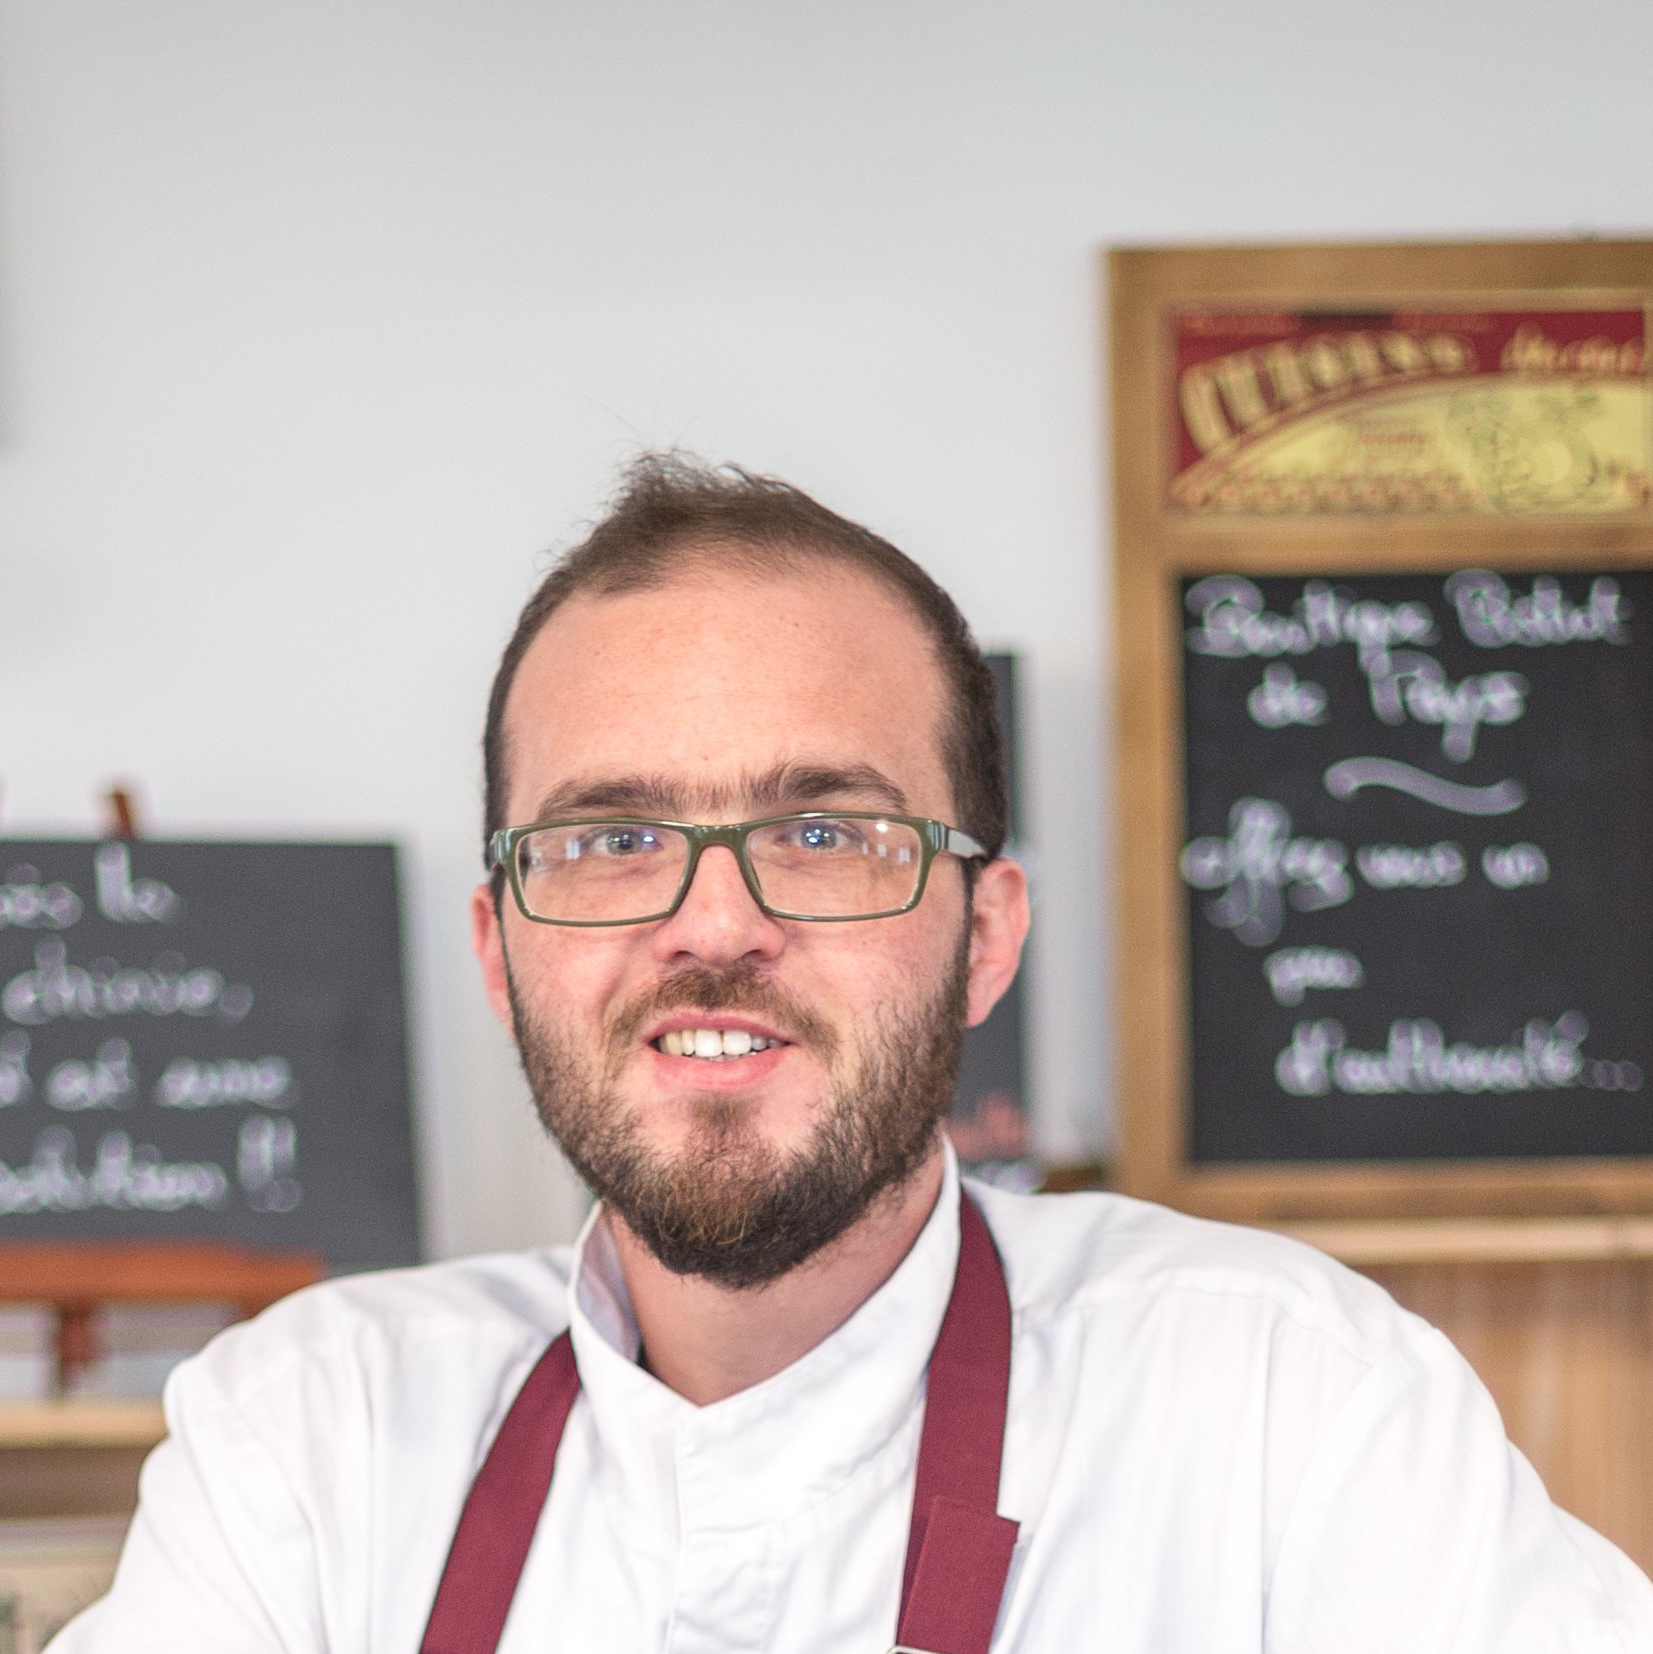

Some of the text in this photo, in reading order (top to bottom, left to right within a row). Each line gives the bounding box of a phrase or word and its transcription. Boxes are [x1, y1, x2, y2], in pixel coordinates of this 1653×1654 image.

[1248, 661, 1329, 728] de
[46, 1037, 139, 1112] est
[154, 1055, 297, 1111] une
